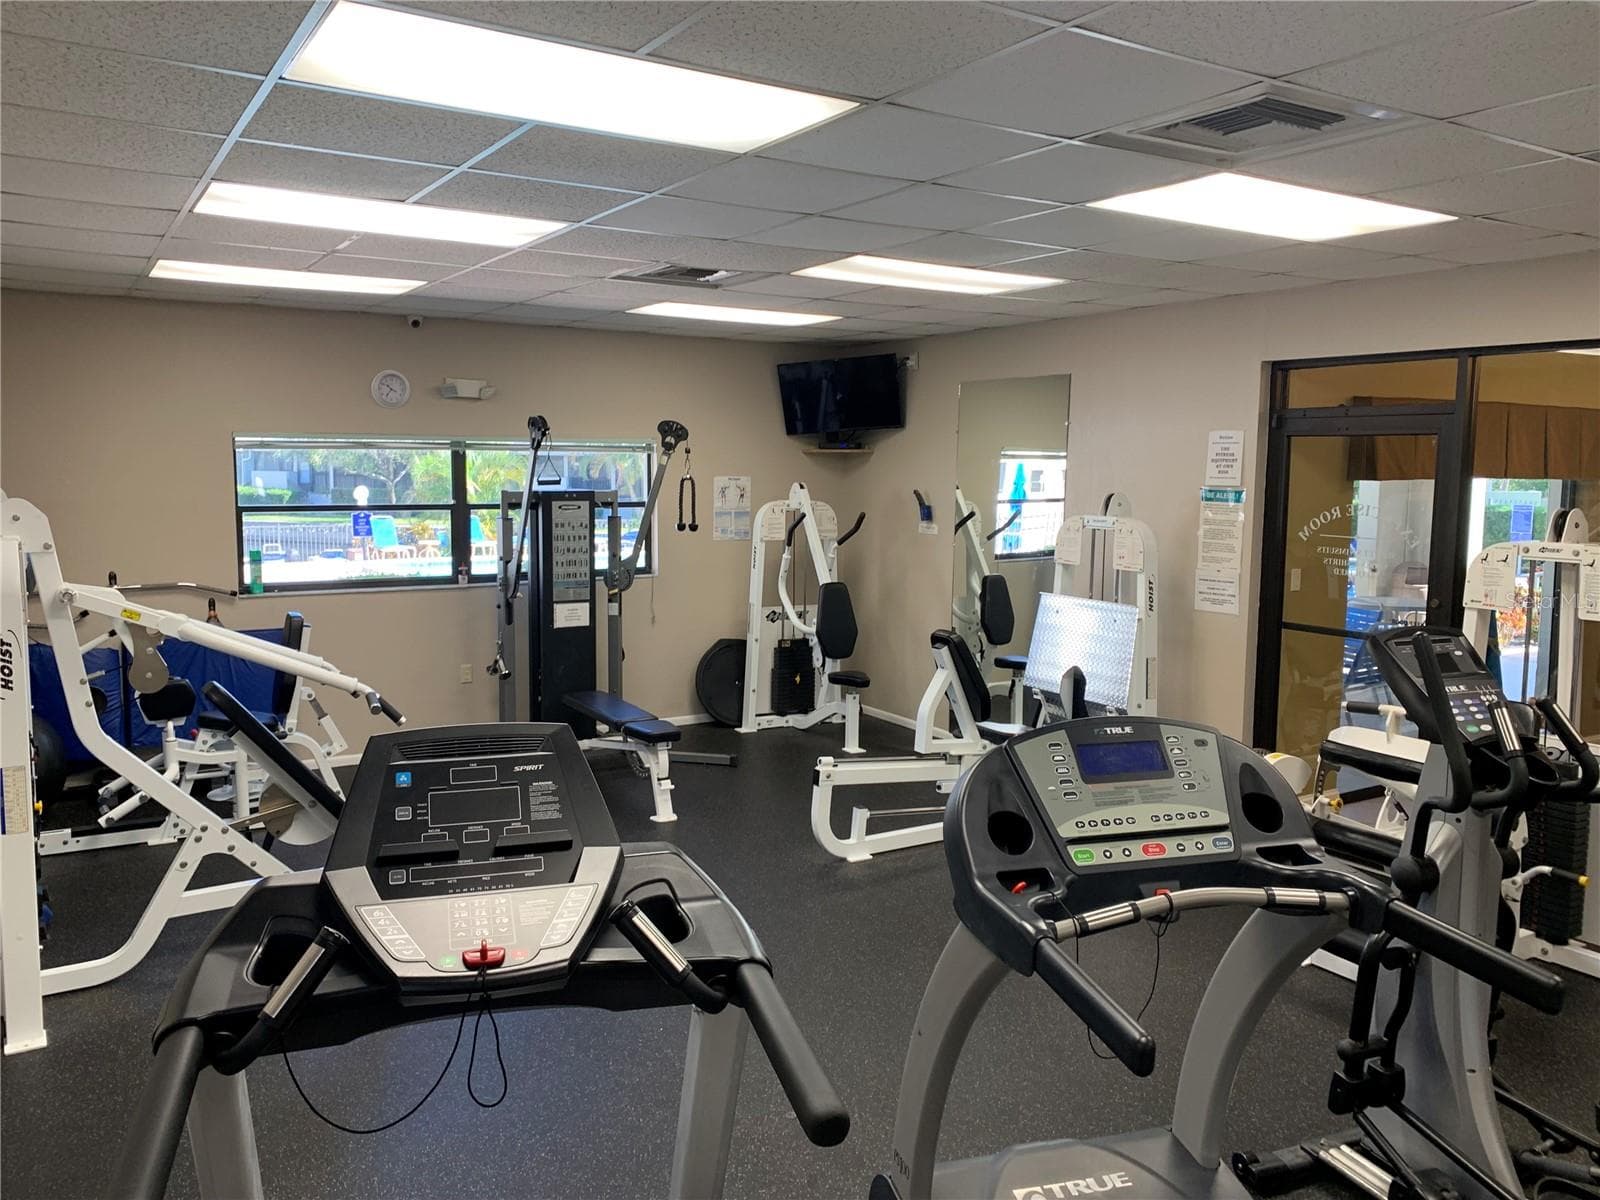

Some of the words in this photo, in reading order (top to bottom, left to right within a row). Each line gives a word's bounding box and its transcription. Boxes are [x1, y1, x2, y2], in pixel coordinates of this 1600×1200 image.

[0, 638, 14, 692] HOIST
[1104, 726, 1135, 735] TRUE
[512, 763, 545, 773] SPIRIT
[1043, 1171, 1134, 1199] TRUE
